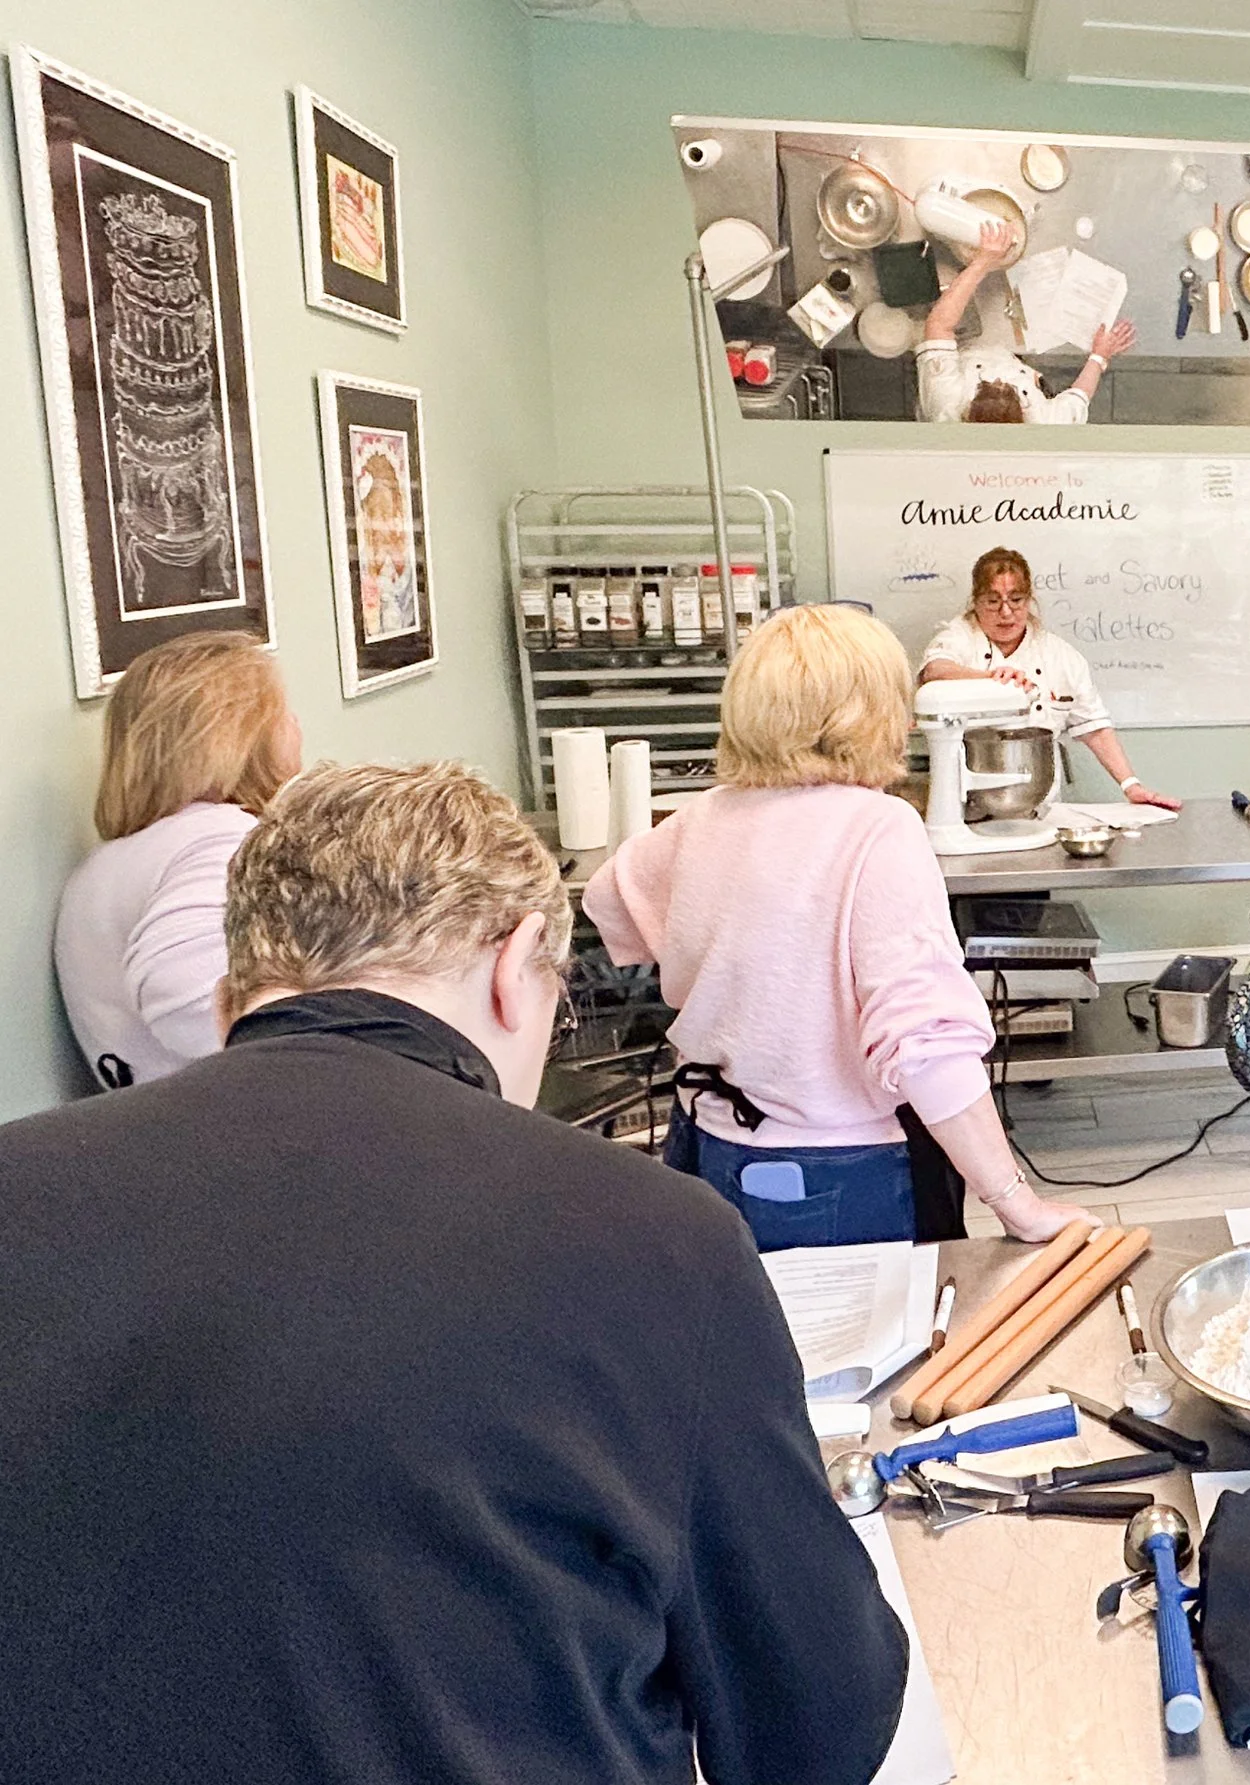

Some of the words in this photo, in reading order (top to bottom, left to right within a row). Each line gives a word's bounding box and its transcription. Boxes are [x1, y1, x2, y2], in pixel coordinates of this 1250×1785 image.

[969, 472, 1060, 488] Welcome
[901, 499, 994, 526] Amie
[994, 491, 1140, 522] Academie
[1084, 571, 1111, 586] and
[1119, 559, 1203, 602] Savory
